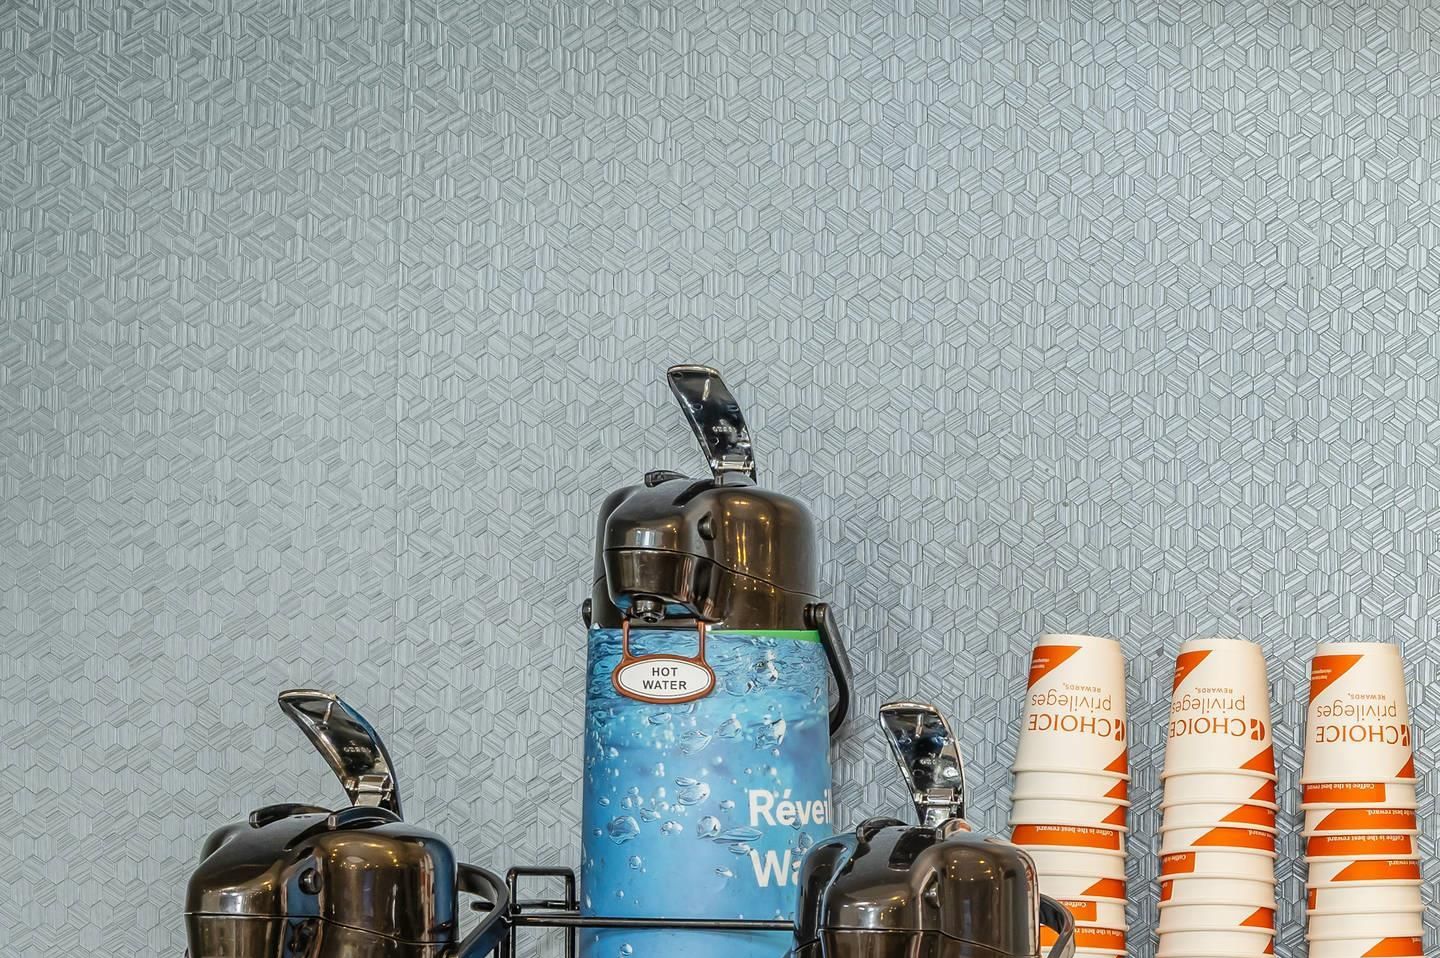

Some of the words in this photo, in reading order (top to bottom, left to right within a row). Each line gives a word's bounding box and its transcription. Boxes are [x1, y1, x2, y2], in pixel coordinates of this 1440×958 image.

[652, 666, 678, 678] HOT
[642, 678, 688, 692] WATER
[1032, 689, 1112, 712] privileges
[1316, 700, 1396, 721] privileges
[1028, 714, 1112, 737] CHOICE
[1170, 718, 1246, 738] CHOICE
[1316, 724, 1398, 744] CHOICE
[750, 848, 800, 888] W
